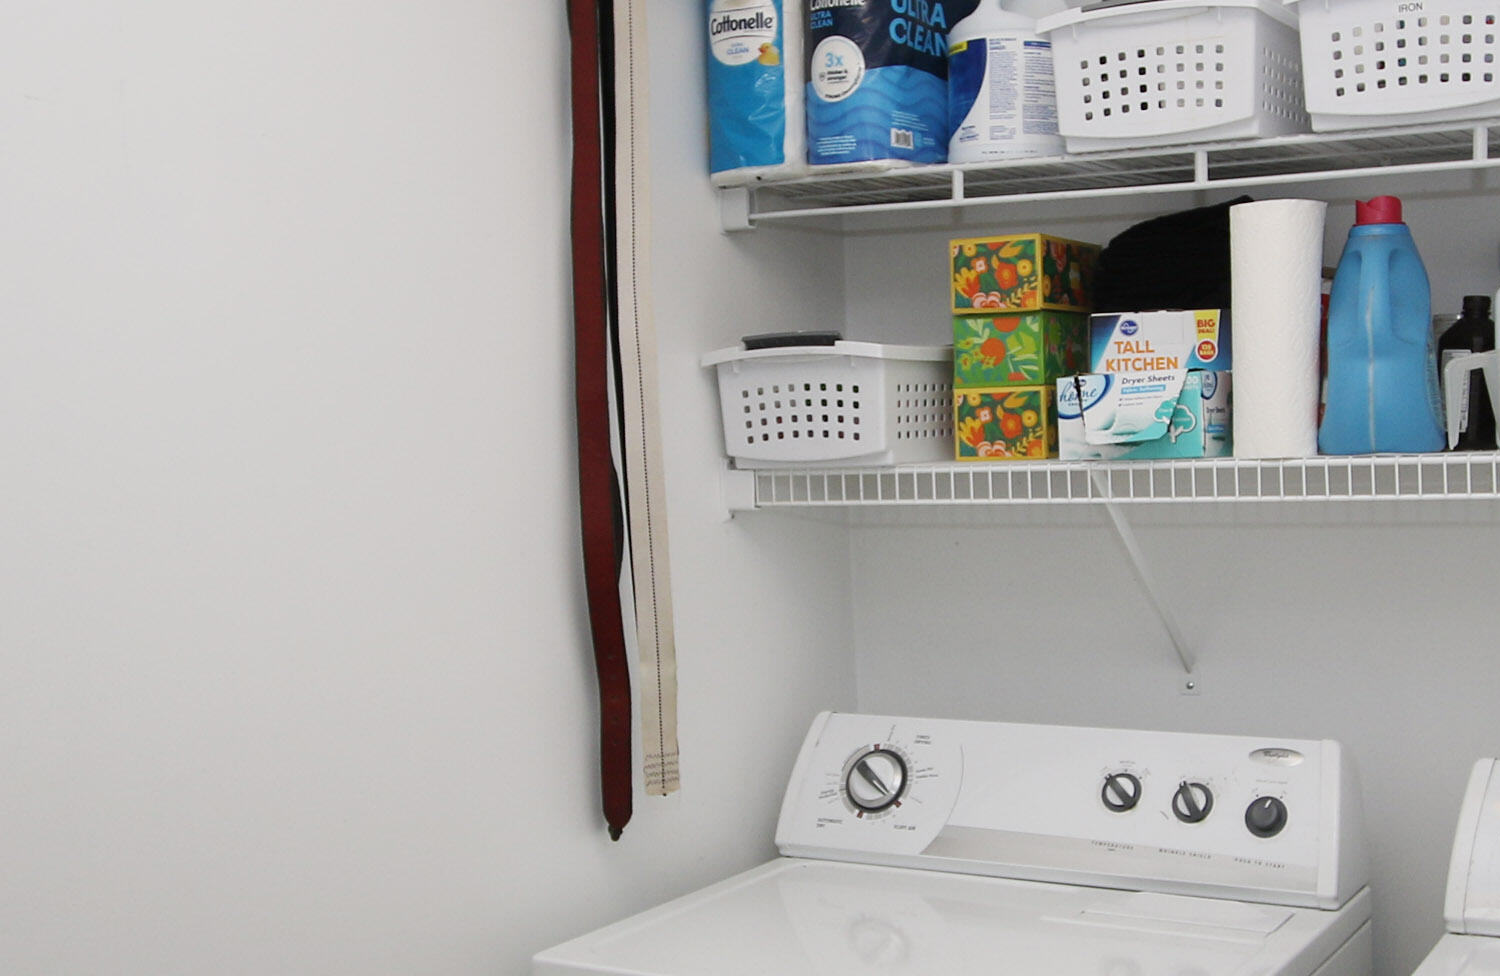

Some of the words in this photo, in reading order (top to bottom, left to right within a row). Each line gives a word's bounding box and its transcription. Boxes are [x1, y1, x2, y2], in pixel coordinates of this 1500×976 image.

[890, 0, 947, 29] ULTRA
[1399, 3, 1423, 13] IRON
[711, 12, 774, 36] Cottonelle
[889, 17, 949, 57] CLEAN
[824, 52, 844, 68] 3x
[1197, 319, 1216, 328] BIG
[1114, 340, 1156, 354] TALL
[1105, 356, 1179, 372] KITCHEN
[1122, 377, 1146, 386] Dryer
[1147, 375, 1175, 383] Sheets
